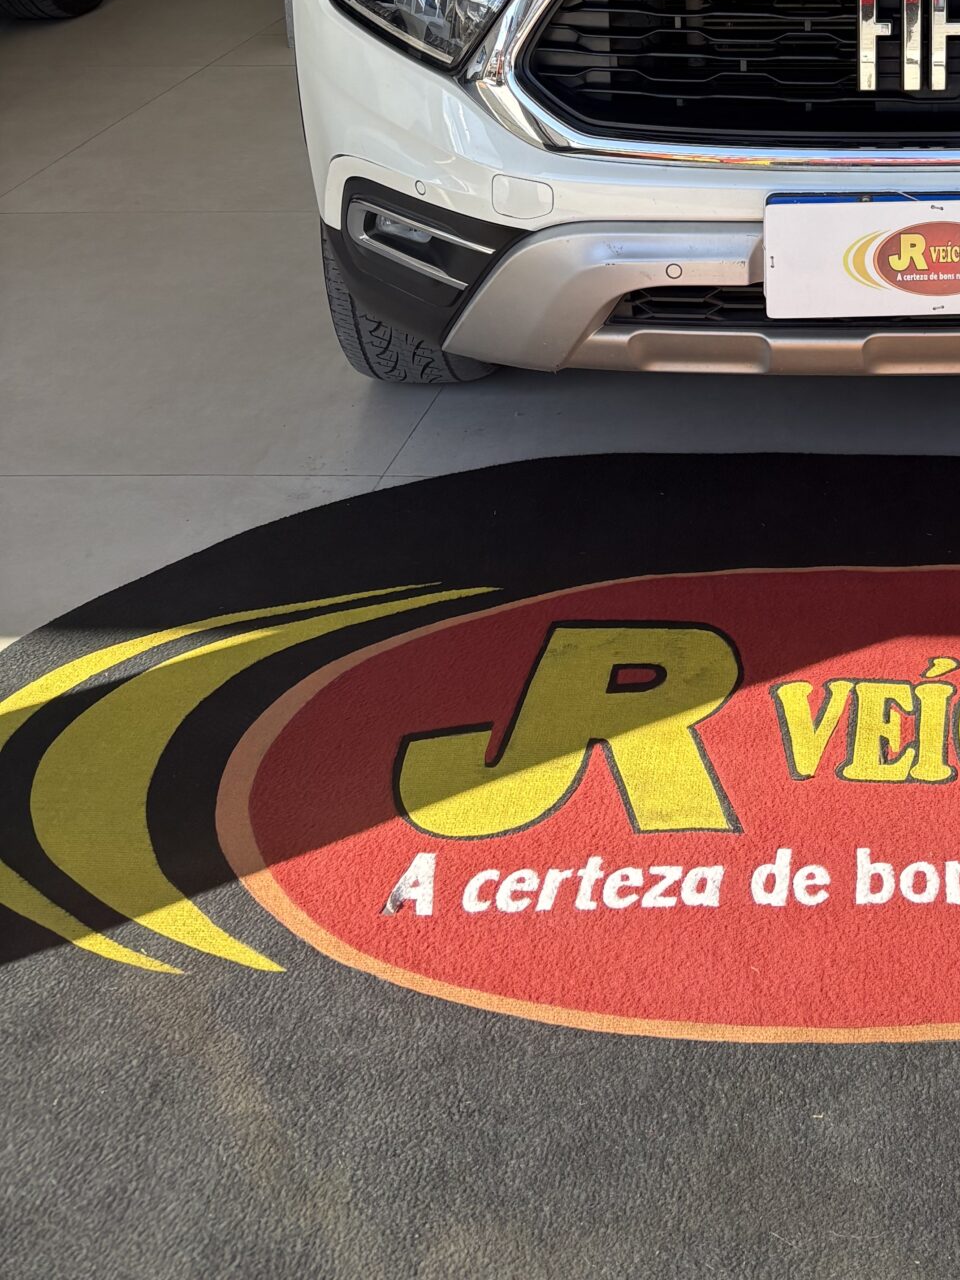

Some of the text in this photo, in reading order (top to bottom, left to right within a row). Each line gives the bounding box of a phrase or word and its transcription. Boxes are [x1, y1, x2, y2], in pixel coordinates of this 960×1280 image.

[888, 233, 929, 271] JR
[896, 273, 903, 281] A
[903, 272, 928, 281] certeza
[929, 272, 938, 280] de
[939, 272, 955, 280] bons
[394, 620, 741, 840] JR
[380, 852, 437, 917] A
[462, 855, 725, 914] certeza
[750, 847, 832, 908] de
